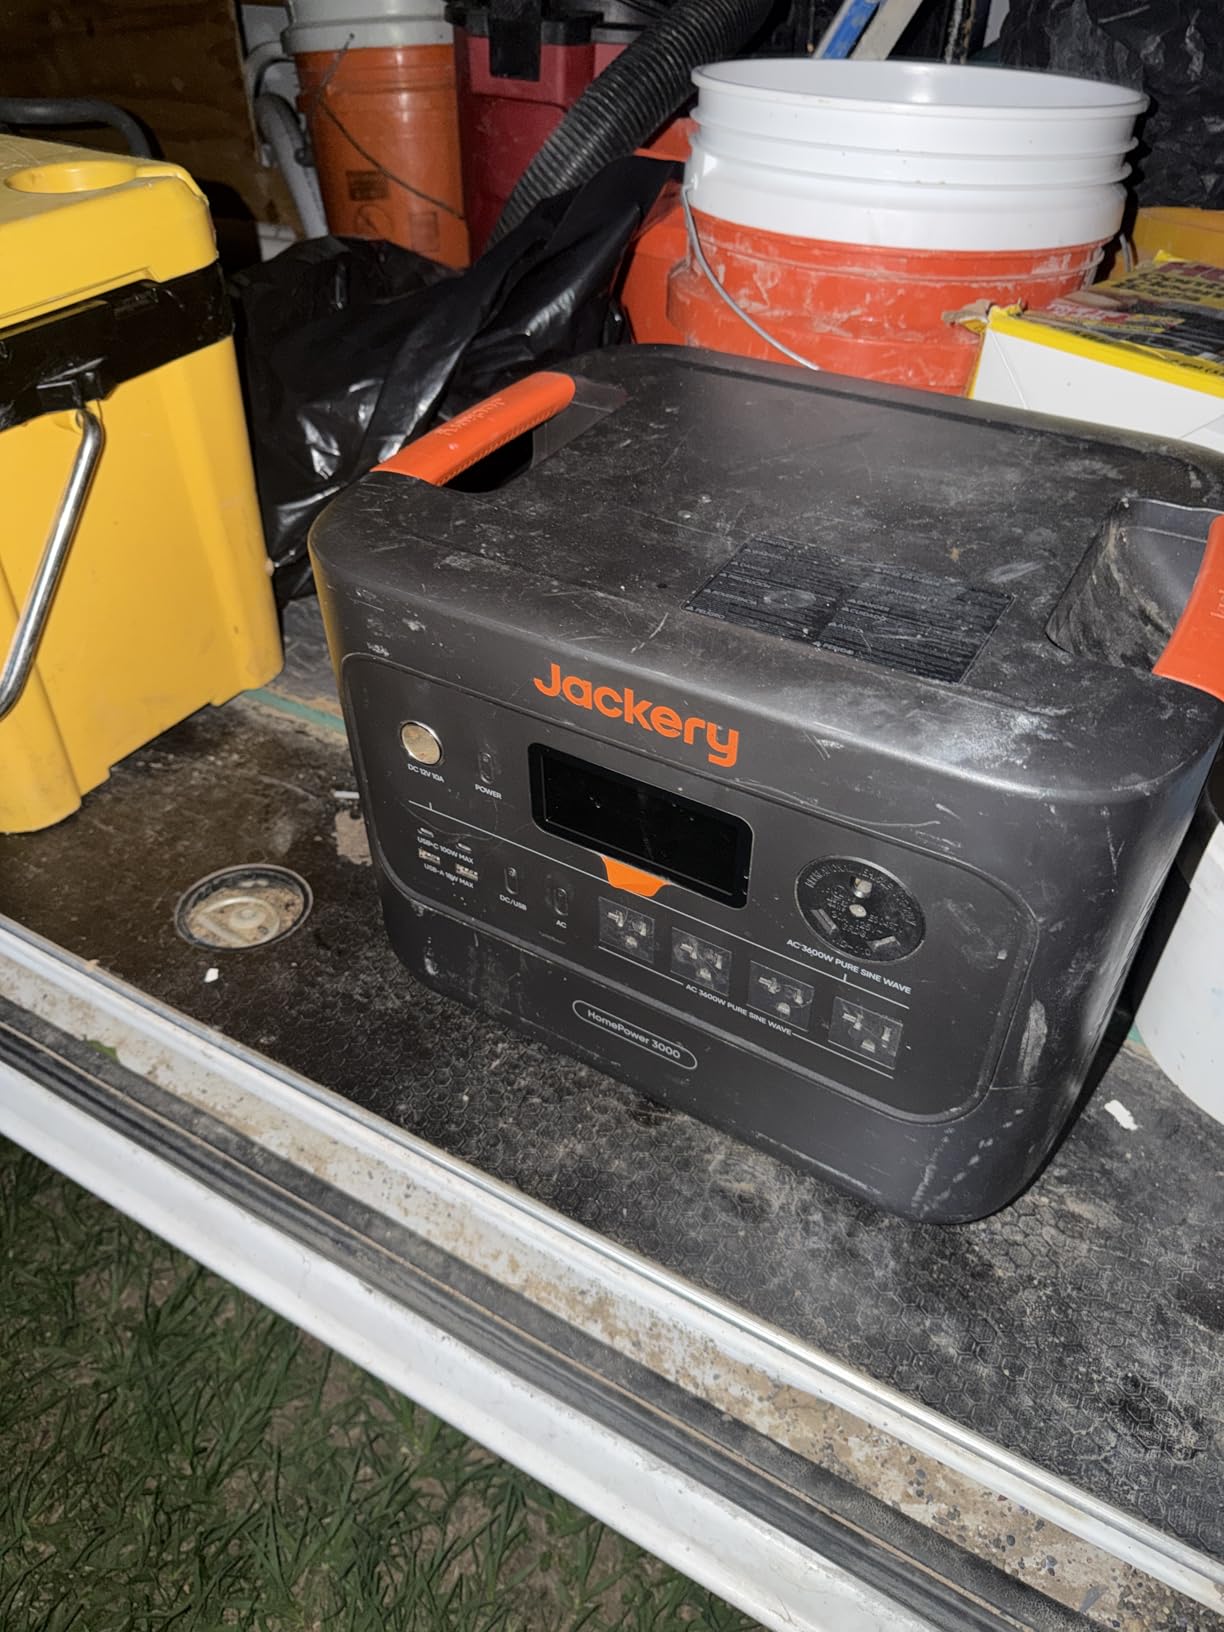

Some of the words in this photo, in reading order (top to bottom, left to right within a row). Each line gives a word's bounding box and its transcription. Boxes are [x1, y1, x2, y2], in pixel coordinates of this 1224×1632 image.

[533, 663, 740, 767] Jackery
[407, 763, 420, 773] DC
[420, 767, 431, 777] 12V
[432, 772, 445, 783] 10A
[474, 783, 502, 799] POWER
[417, 836, 439, 850] USB-C
[440, 845, 458, 857] 100W
[459, 853, 474, 864] MAX
[424, 863, 445, 877] USB-A
[459, 878, 474, 888] MAX
[499, 894, 527, 911] DC/USB
[556, 920, 567, 929] AC
[786, 939, 801, 950] AC
[801, 944, 835, 963] 3600W
[835, 958, 859, 974] PURE
[860, 968, 882, 982] SINE
[883, 977, 912, 995] WAVE
[685, 984, 698, 994] AC
[698, 989, 726, 1006] 3600W
[727, 1001, 748, 1016] PURE
[748, 1011, 767, 1025] SINE
[767, 1020, 792, 1036] WAVE
[587, 1009, 650, 1044] HomePower
[651, 1039, 681, 1059] 3000
